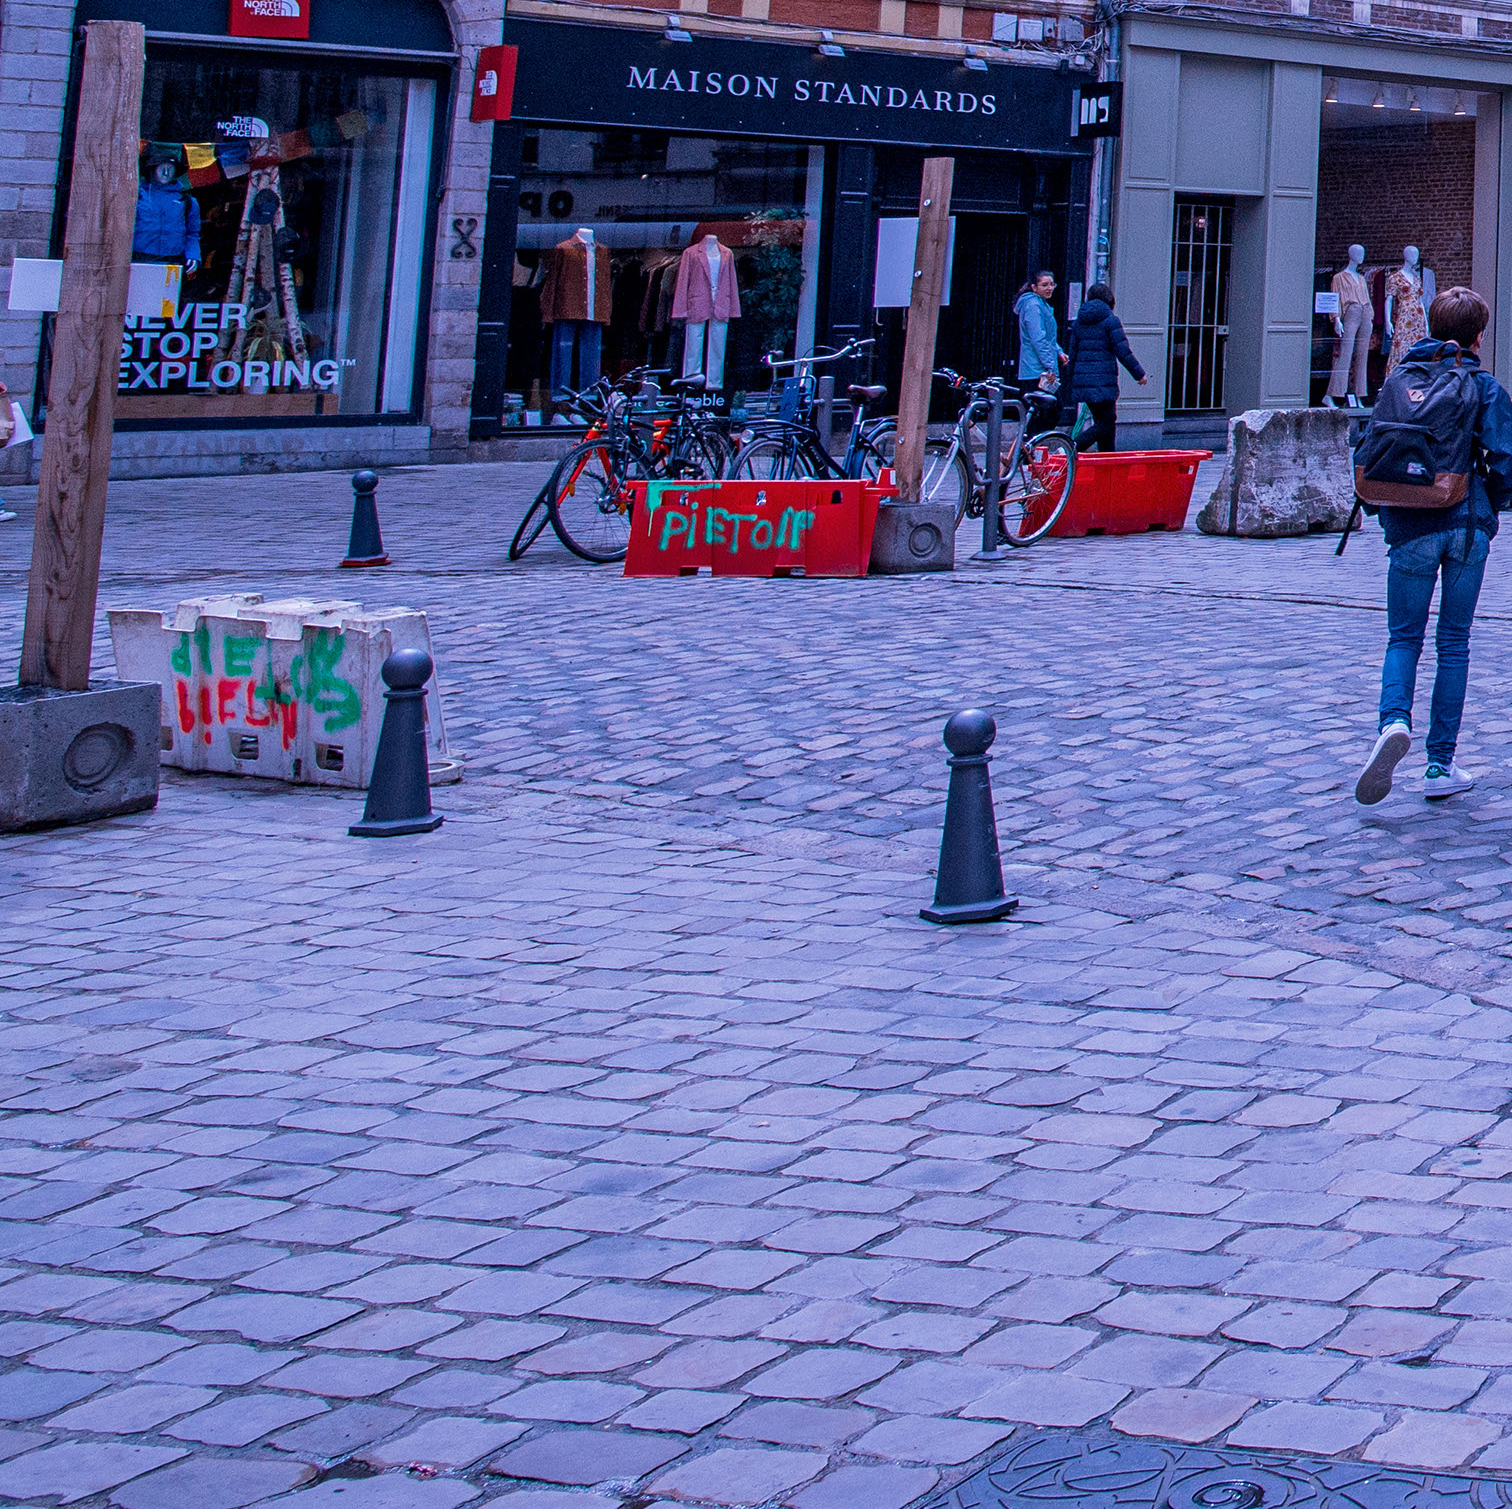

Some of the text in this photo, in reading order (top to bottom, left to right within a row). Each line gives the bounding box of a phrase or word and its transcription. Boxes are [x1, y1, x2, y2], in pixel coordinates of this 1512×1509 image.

[243, 0, 281, 9] NORTH
[253, 8, 281, 17] FACE
[626, 65, 997, 115] MAISON STANDARDS
[233, 116, 251, 124] THE
[216, 122, 251, 130] NORTH
[226, 129, 251, 138] FACE
